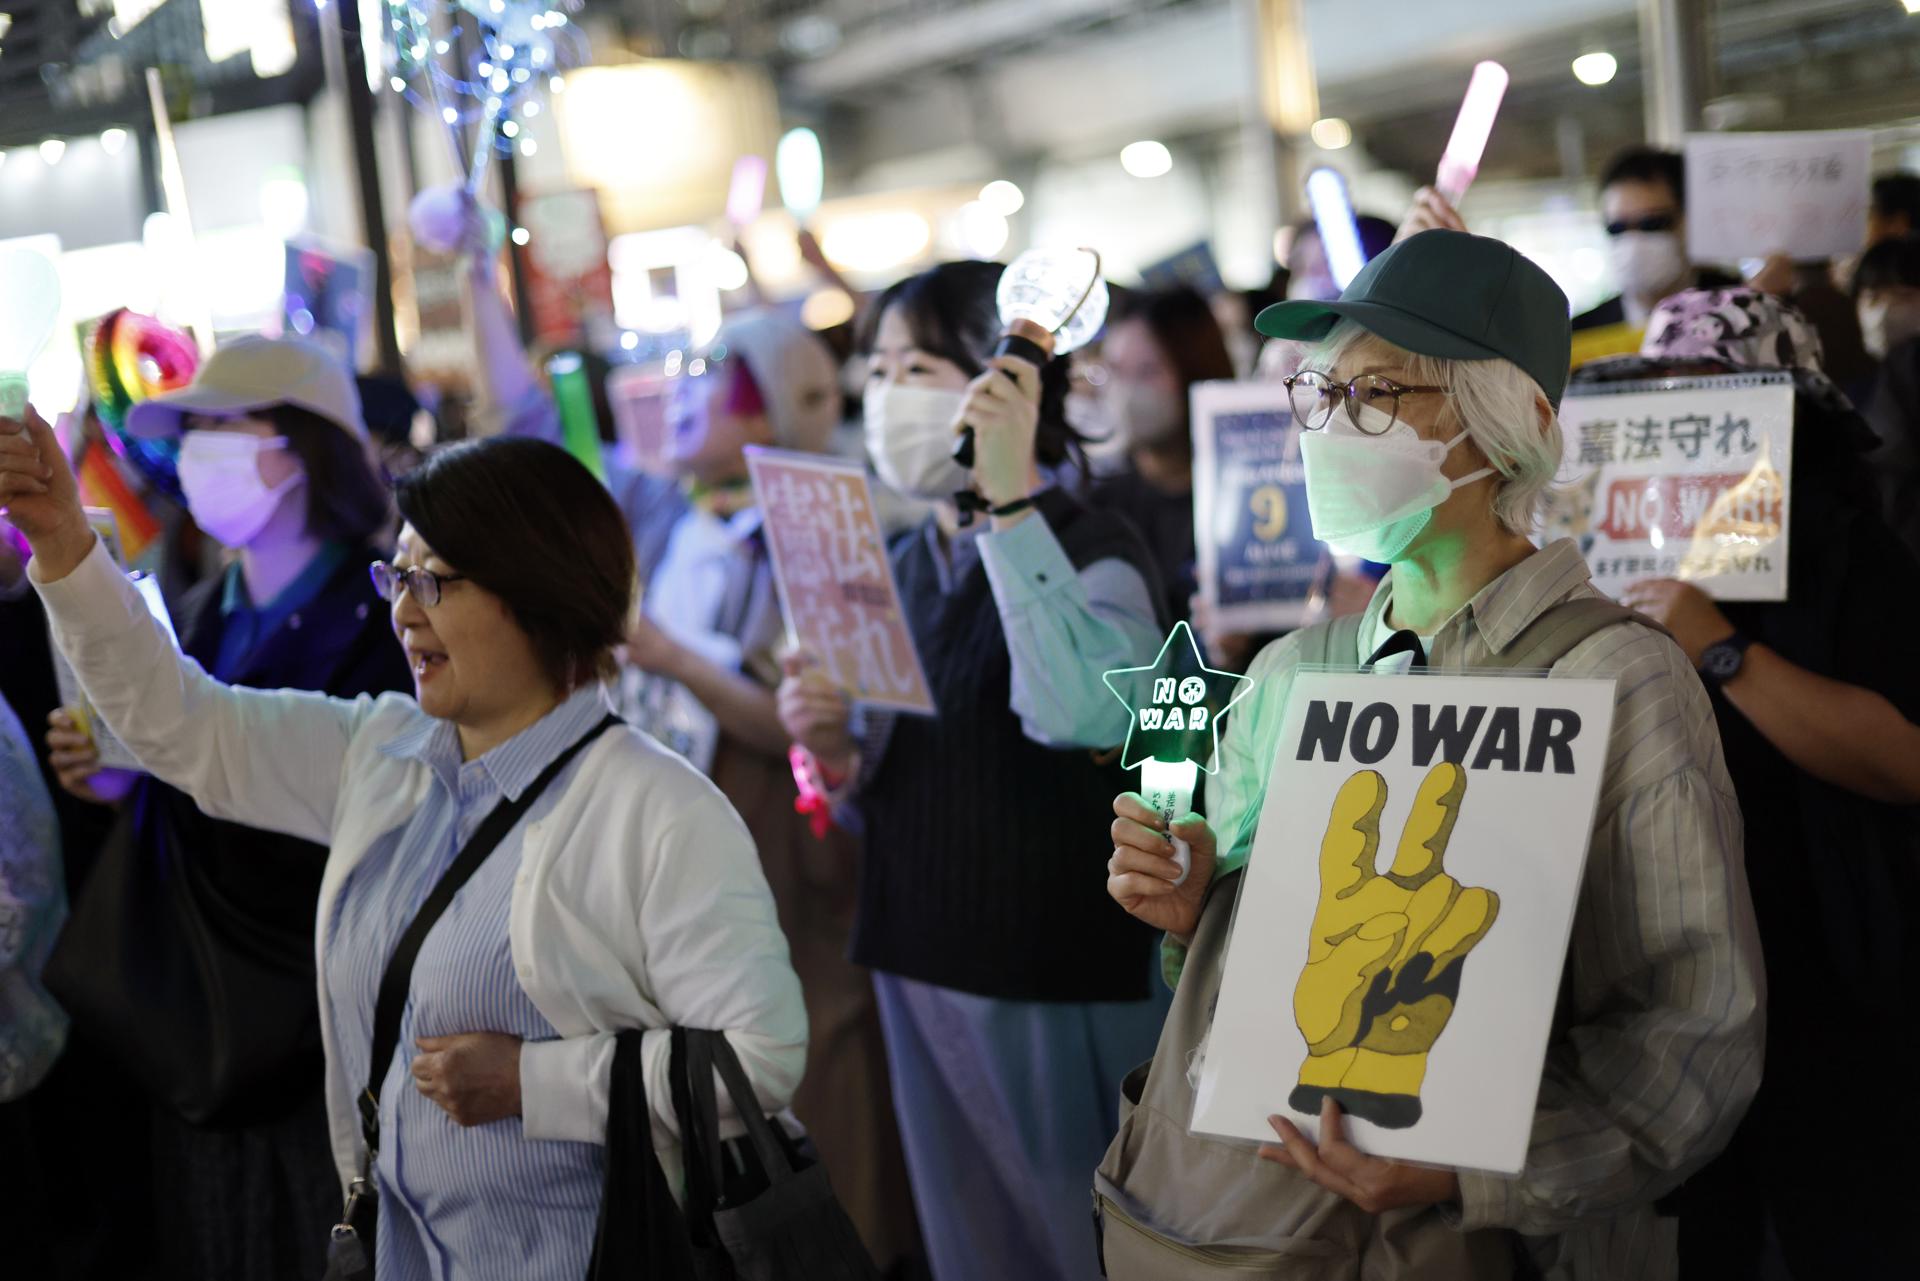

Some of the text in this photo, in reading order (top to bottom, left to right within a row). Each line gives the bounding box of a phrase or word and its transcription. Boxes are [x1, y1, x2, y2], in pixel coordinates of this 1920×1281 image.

[1579, 411, 1757, 464] 憲法守れ
[1249, 484, 1289, 543] 9
[1613, 482, 1778, 532] NO WAR!
[1152, 676, 1206, 705] NO
[1139, 707, 1208, 731] WAR
[1296, 700, 1582, 774] NO WAR
